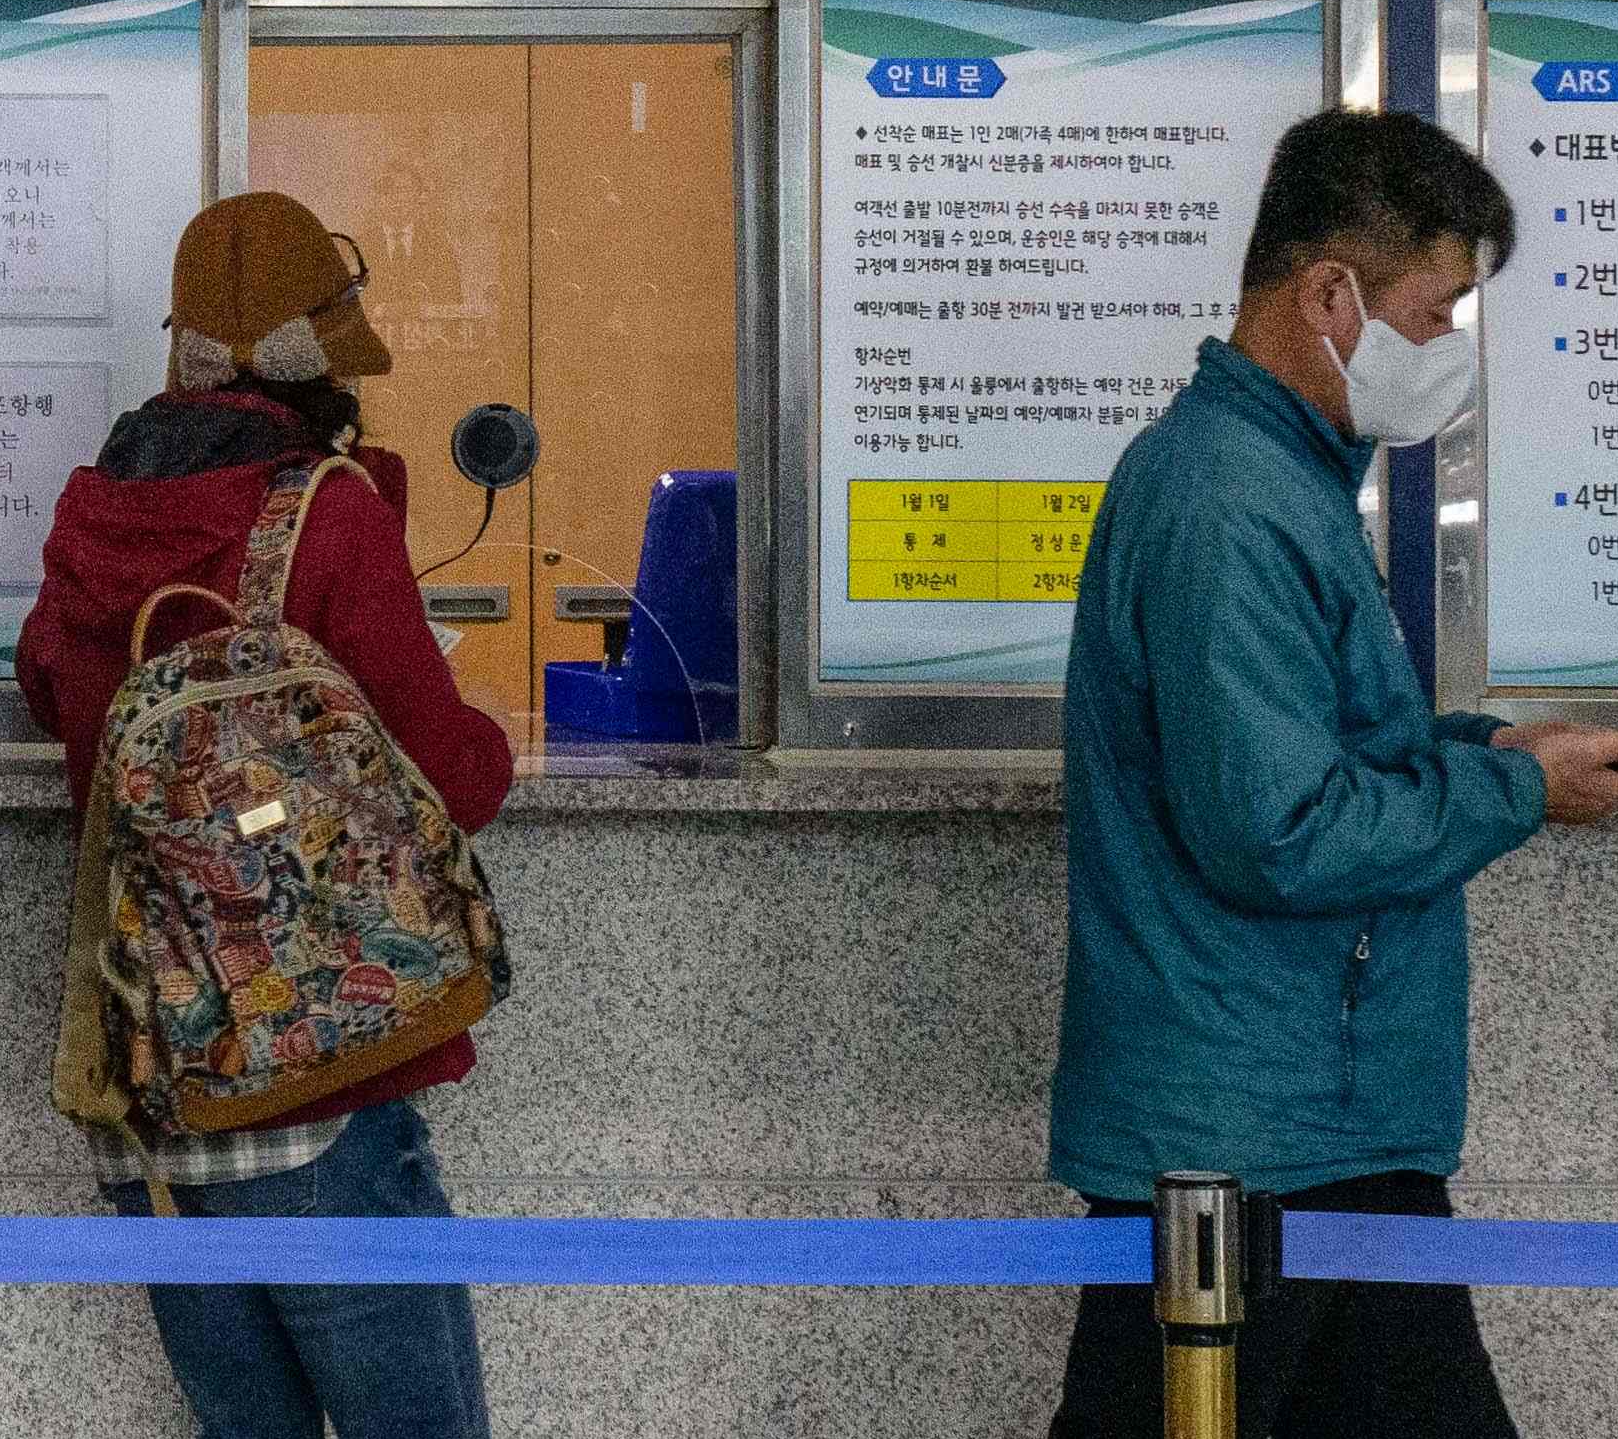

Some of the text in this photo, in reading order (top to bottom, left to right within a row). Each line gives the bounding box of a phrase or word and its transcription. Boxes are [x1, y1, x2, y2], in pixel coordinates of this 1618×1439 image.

[887, 64, 982, 94] 안내문
[1557, 68, 1611, 94] ARS
[873, 124, 916, 144] 선착순
[921, 125, 964, 144] 매표는
[970, 125, 991, 144] 1인
[1105, 125, 1148, 145] 한하여
[1153, 125, 1230, 145] 매표합니다.
[1577, 199, 1616, 233] 1번
[1574, 263, 1618, 298] 2번
[1574, 328, 1618, 362] 3번
[1574, 483, 1618, 517] 4번
